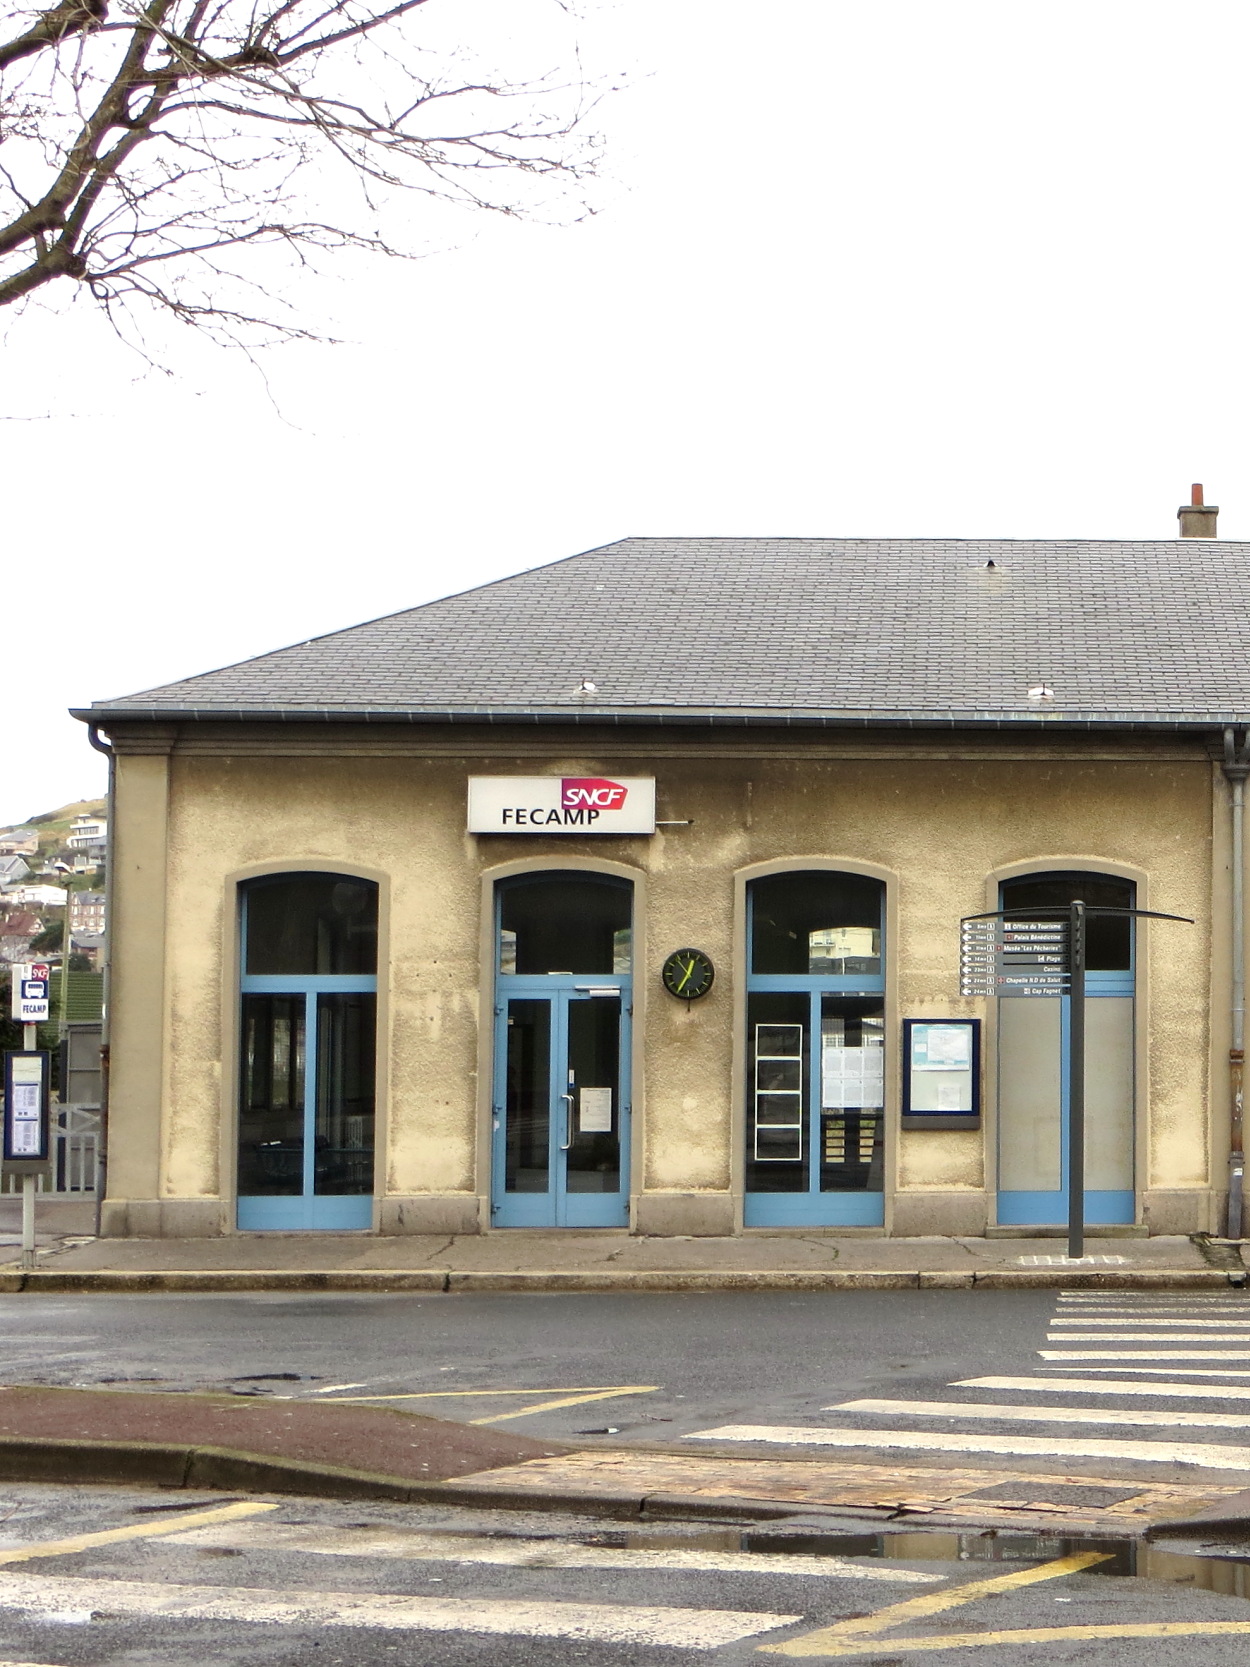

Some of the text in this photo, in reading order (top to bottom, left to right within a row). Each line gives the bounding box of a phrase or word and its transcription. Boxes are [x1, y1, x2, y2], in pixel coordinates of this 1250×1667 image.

[563, 788, 624, 806] SNCF
[502, 808, 600, 825] FECAMP
[23, 1004, 46, 1013] FECAMP
